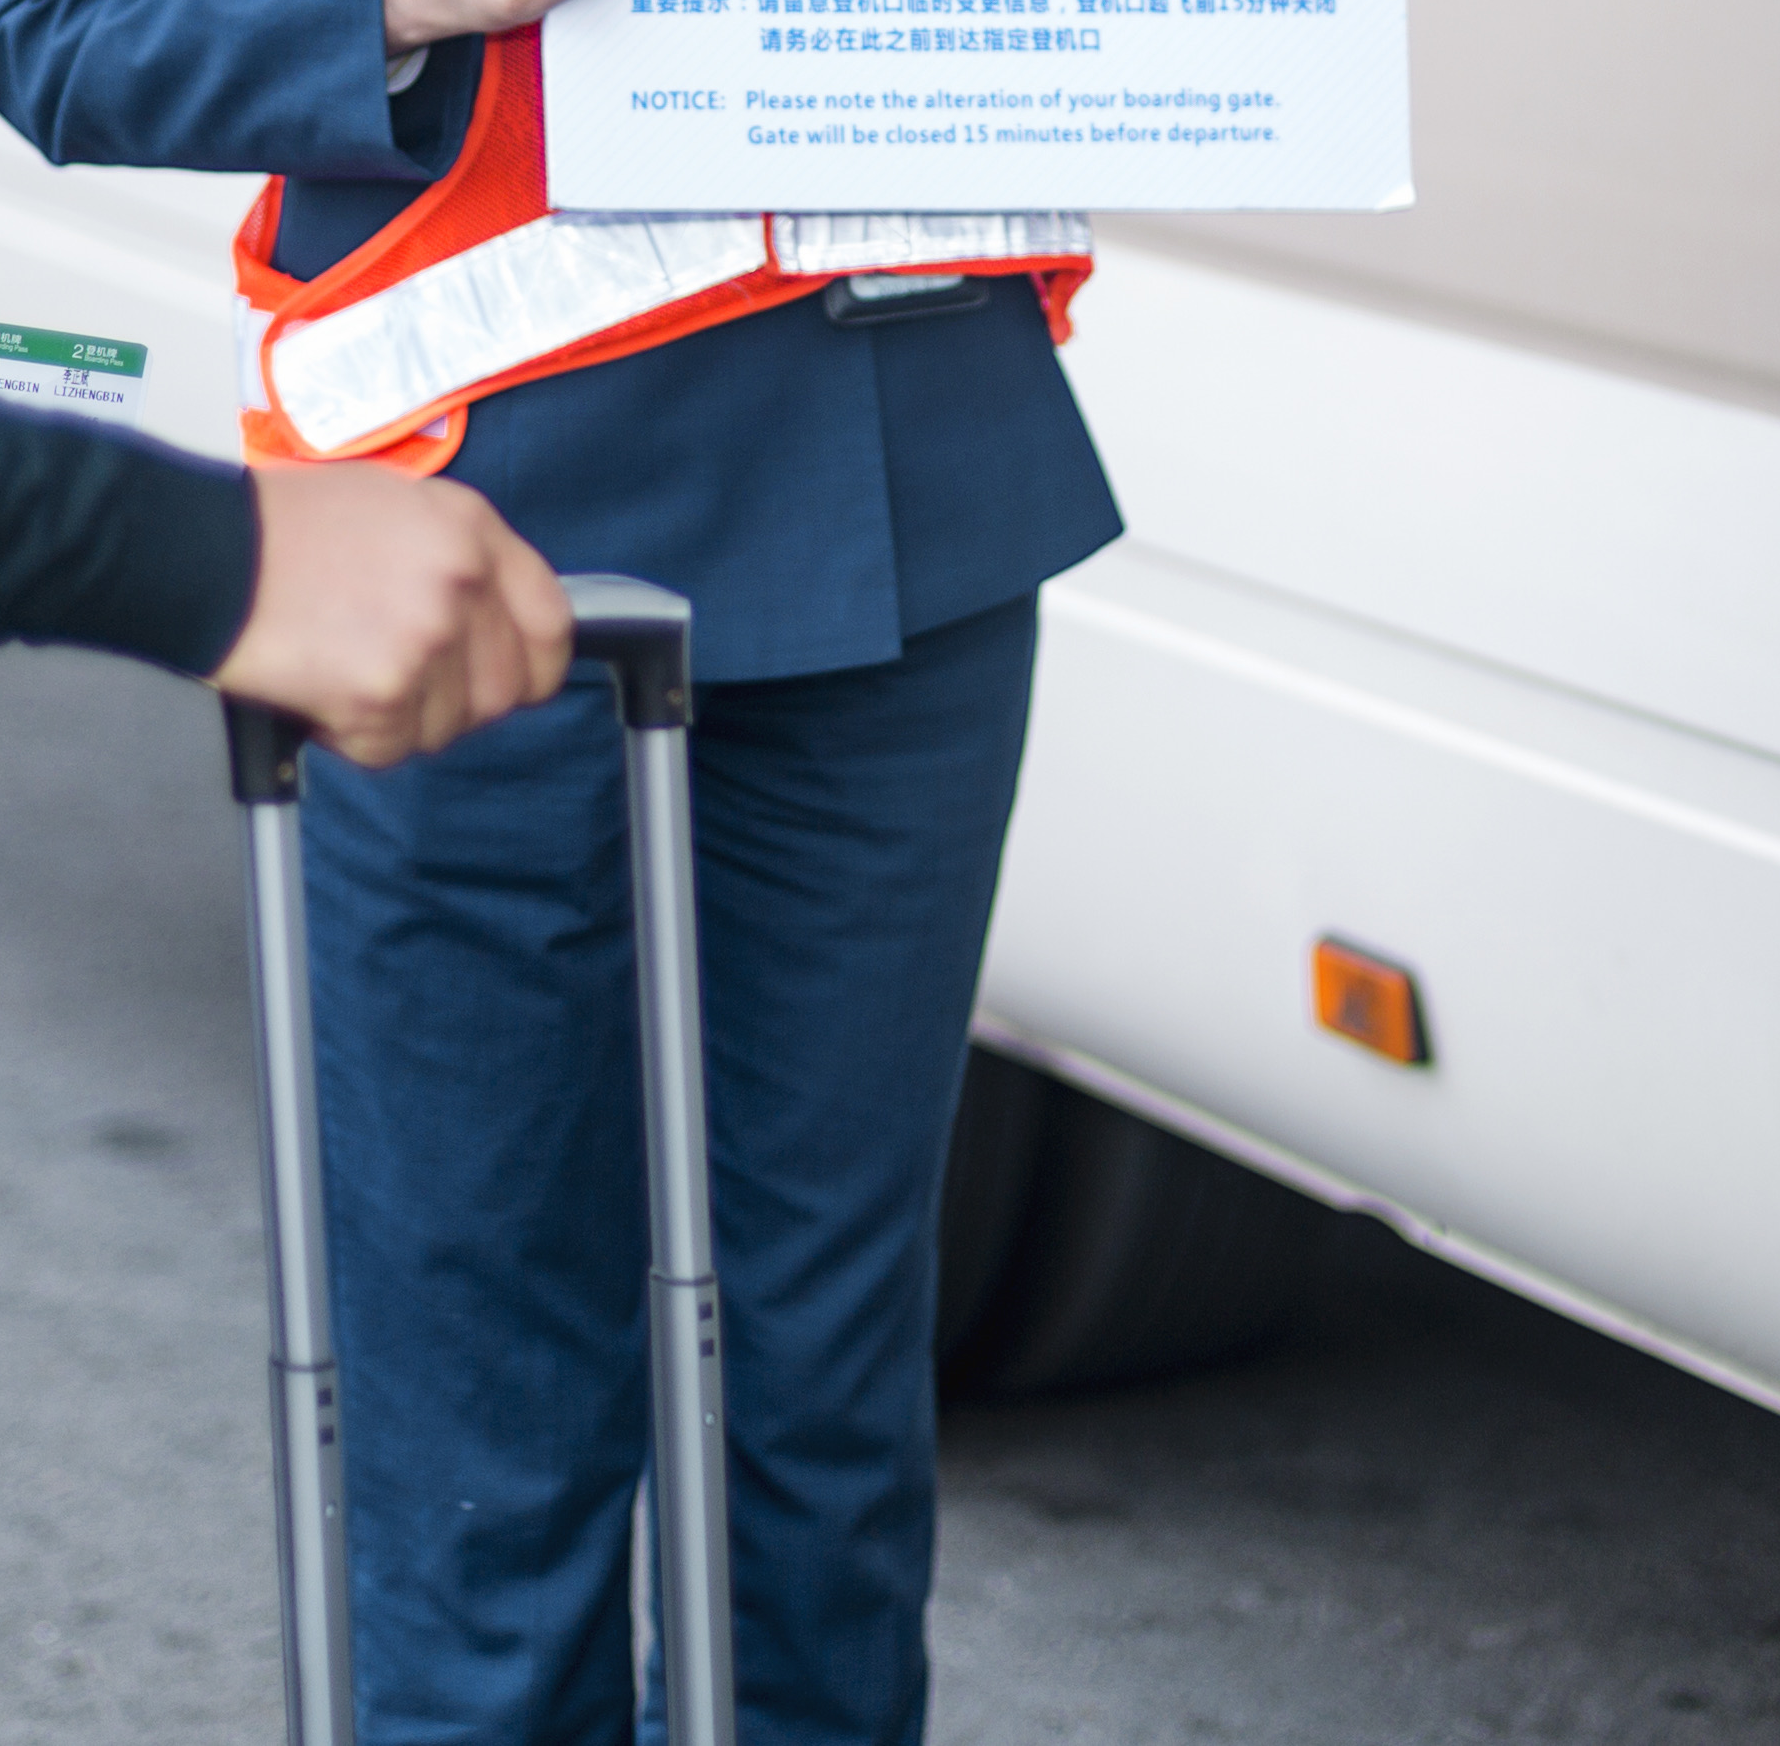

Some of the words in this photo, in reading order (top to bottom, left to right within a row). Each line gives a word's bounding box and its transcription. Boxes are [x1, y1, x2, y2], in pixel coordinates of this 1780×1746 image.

[759, 26, 1102, 54] 请务必在此之前到达指定登机口
[631, 90, 726, 111] NOTICE:
[746, 90, 818, 110] Please
[824, 91, 876, 110] note
[882, 89, 918, 110] the
[924, 88, 1034, 110] alteration
[1040, 87, 1062, 109] of
[1069, 93, 1117, 114] your
[1123, 88, 1222, 114] boarding
[1227, 90, 1281, 114] gate.
[747, 125, 801, 146] Gate
[806, 124, 846, 145] will
[851, 124, 880, 145] be
[885, 124, 958, 145] closed
[965, 124, 990, 145] 15
[996, 124, 1085, 144] minutes
[1090, 122, 1162, 143] before
[1167, 122, 1280, 147] departure.
[14, 344, 29, 353] Pass
[71, 344, 85, 359] 2
[86, 344, 119, 359] 登机牌
[83, 355, 109, 366] Boarding
[109, 357, 124, 367] Pass
[54, 385, 124, 404] LIZHENGBIN
